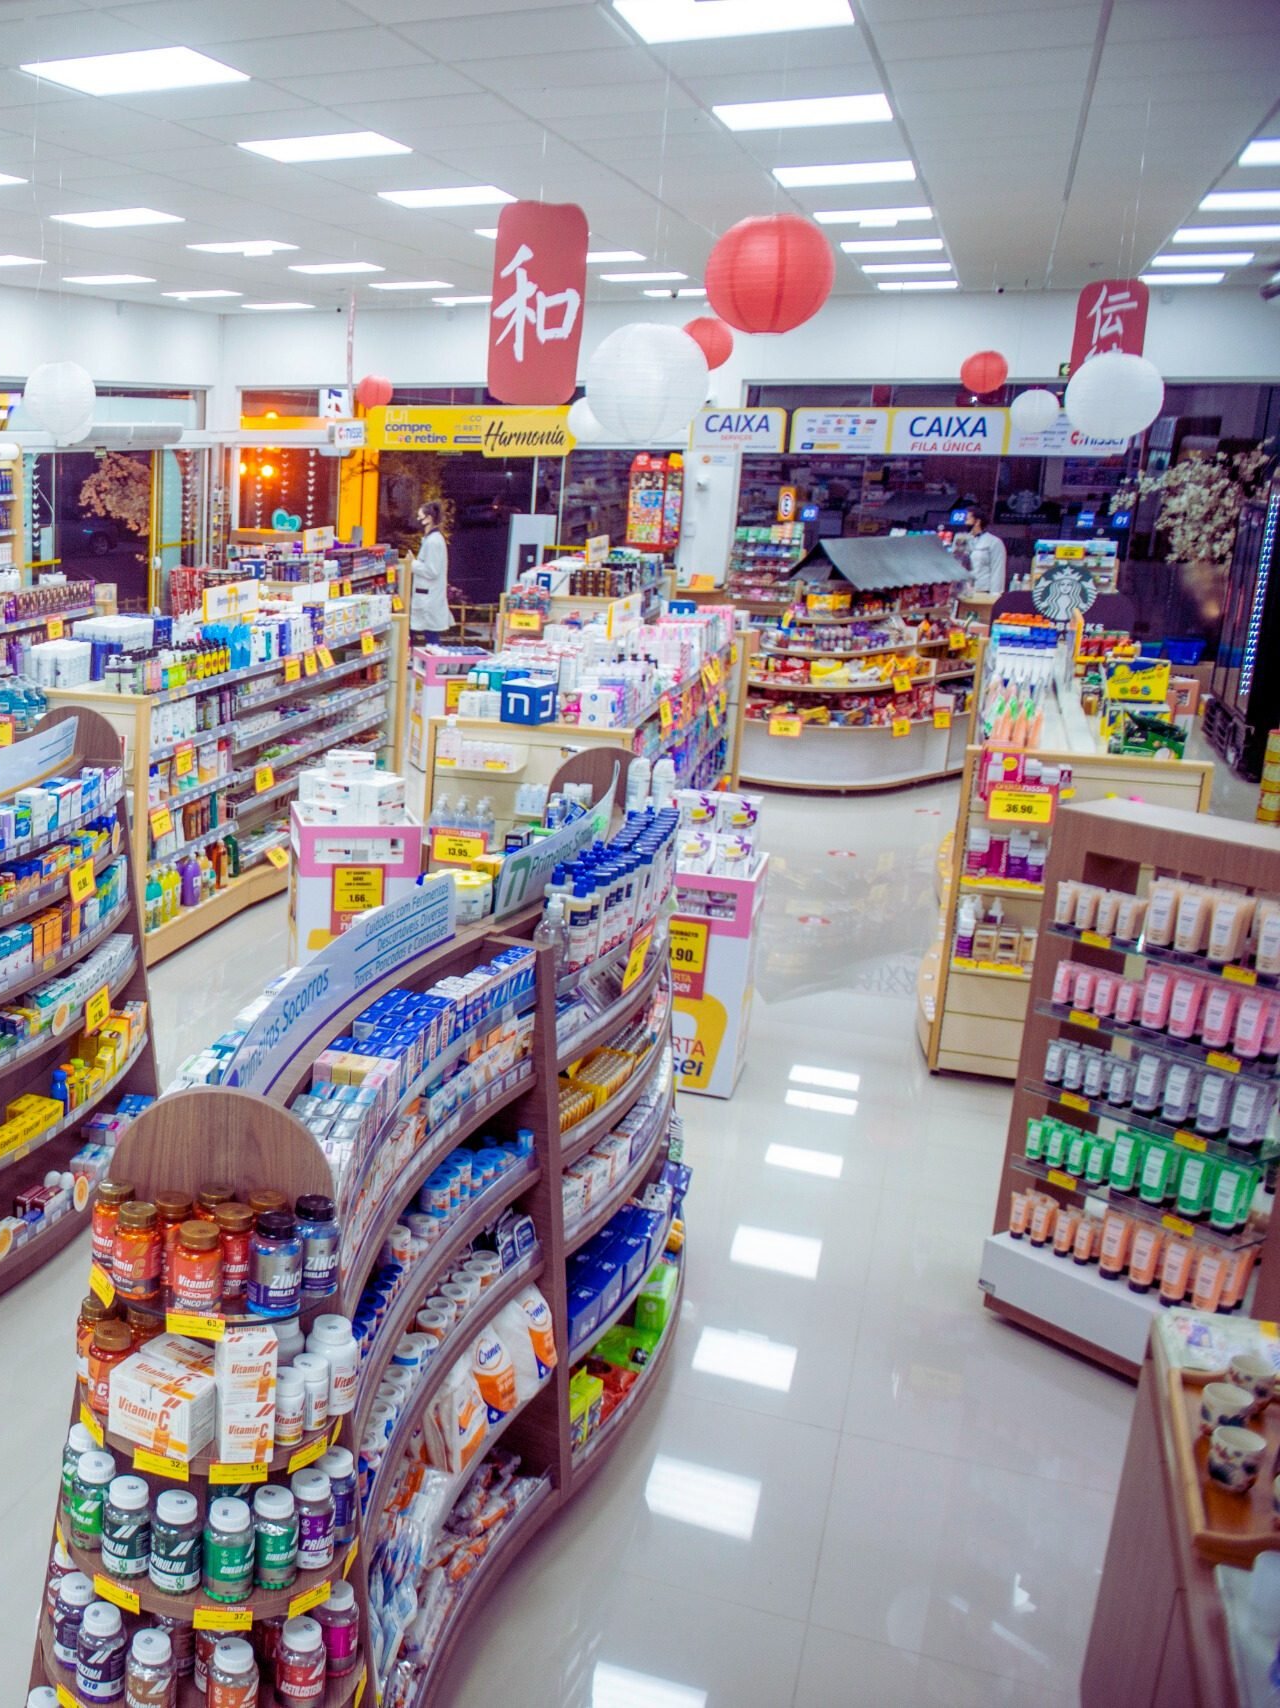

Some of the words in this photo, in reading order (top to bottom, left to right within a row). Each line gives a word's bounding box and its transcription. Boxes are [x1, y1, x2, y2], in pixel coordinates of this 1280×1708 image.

[492, 243, 581, 363] 和
[384, 421, 432, 435] compre
[705, 414, 770, 433] CAIXA
[908, 415, 988, 438] CAIXA
[413, 432, 448, 444] retire
[482, 420, 567, 453] Harmonia
[910, 441, 938, 453] FILA
[942, 439, 982, 453] ÚNICA
[802, 508, 816, 518] 03
[952, 512, 966, 522] 02
[1115, 515, 1128, 525] 01
[365, 909, 395, 937] Cuidados
[396, 902, 411, 919] com
[411, 881, 449, 912] Ferimentos
[238, 1026, 281, 1089] Primeiros
[282, 967, 330, 1033] Socorros
[669, 1036, 706, 1057] RTA
[671, 1056, 704, 1079] sei
[177, 1274, 215, 1290] Vitamin
[270, 1271, 302, 1290] ZINC
[165, 1340, 204, 1360] Vitamin
[201, 1354, 216, 1365] C
[135, 1361, 176, 1383] Vitamin
[173, 1375, 193, 1388] C
[231, 1362, 263, 1375] Vitamin
[261, 1361, 273, 1377] C
[117, 1395, 158, 1423] Vitamin
[158, 1409, 171, 1432] C
[227, 1423, 260, 1436] Vitamin
[259, 1422, 270, 1438] C
[149, 1551, 187, 1575] SPIRULINA
[82, 1679, 99, 1691] Q10
